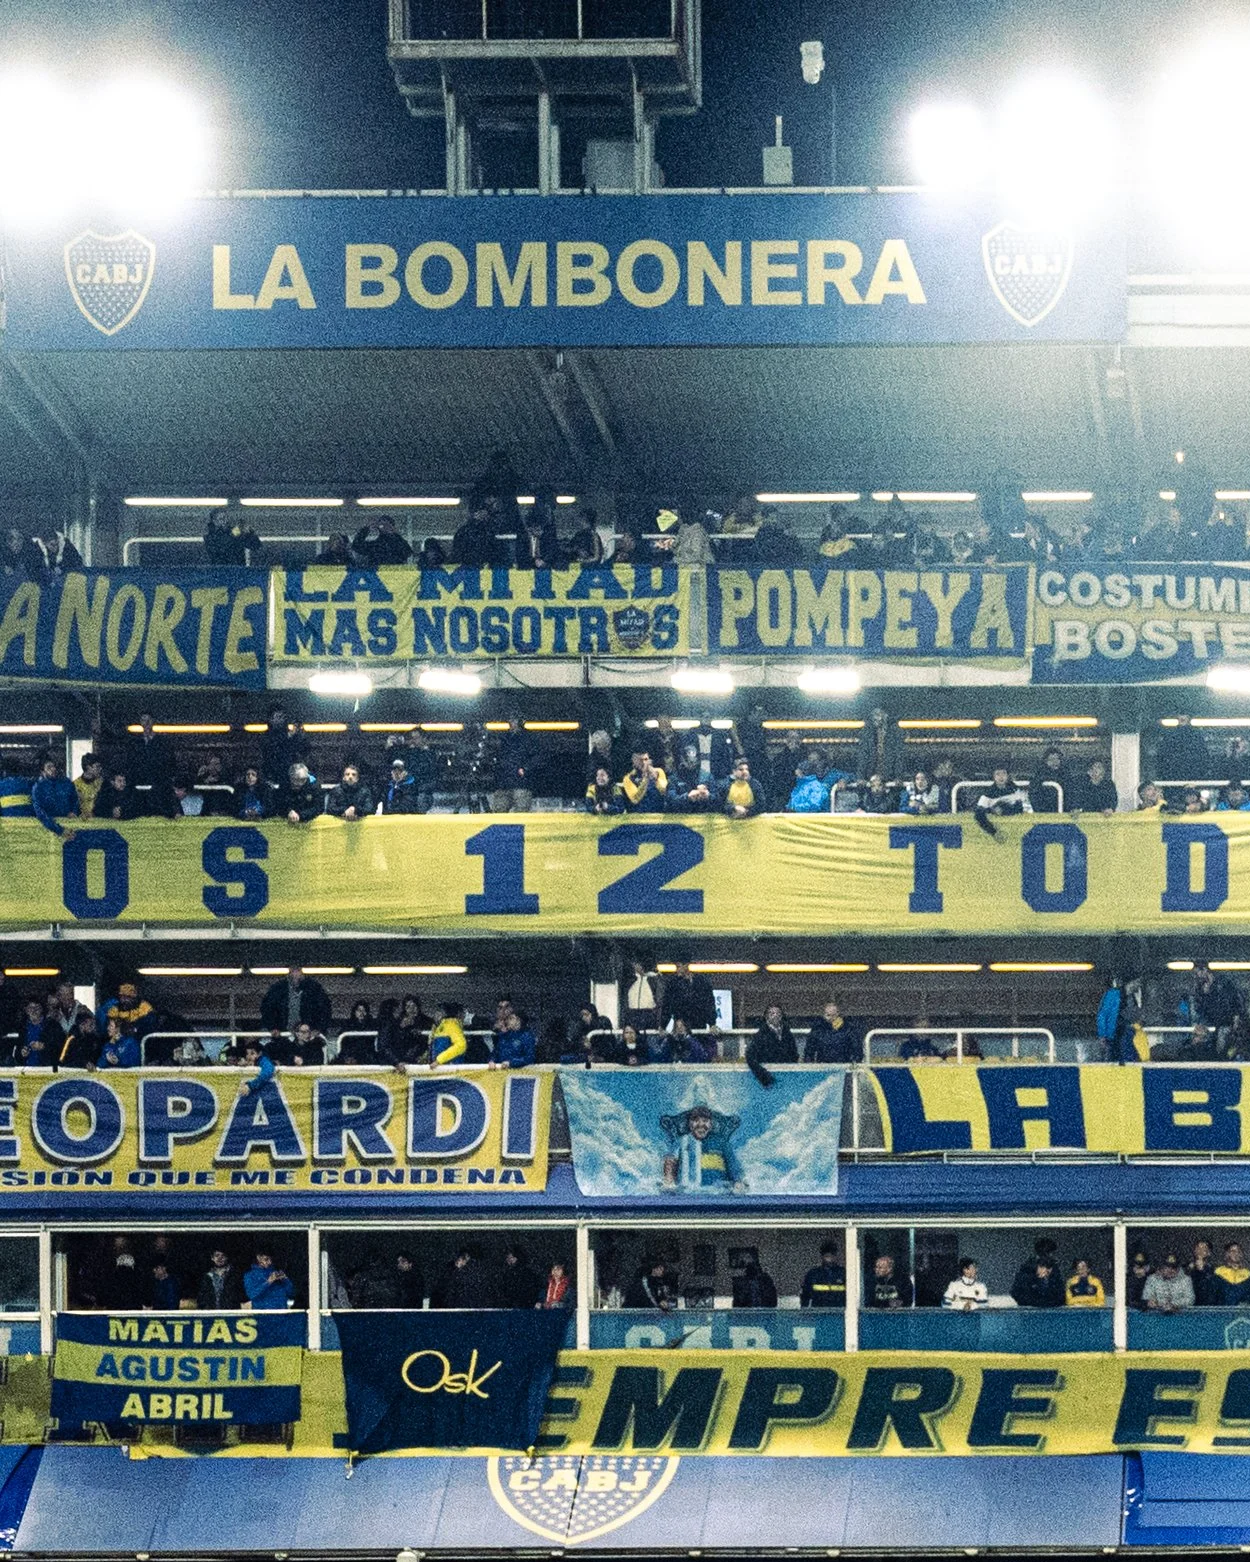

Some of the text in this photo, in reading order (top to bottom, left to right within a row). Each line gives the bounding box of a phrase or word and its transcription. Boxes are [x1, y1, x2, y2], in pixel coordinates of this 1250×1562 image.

[77, 263, 144, 285] CABJ
[212, 238, 928, 311] LA BOMBONERA
[284, 563, 682, 602] LA MITAD
[52, 571, 264, 675] NORTE
[716, 568, 1029, 650] POMPEYA
[283, 603, 681, 657] MAS NOSOTRS
[62, 826, 270, 920] OS
[464, 823, 705, 915] 12
[869, 1066, 1088, 1153] LA
[128, 1170, 216, 1187] QUE
[230, 1170, 297, 1186] ME
[309, 1168, 527, 1186] CONDENA
[108, 1318, 258, 1343] MATIAS
[96, 1353, 266, 1382] AGUSTIN
[120, 1392, 234, 1420] ABRIL
[509, 1468, 652, 1493] CABJ
